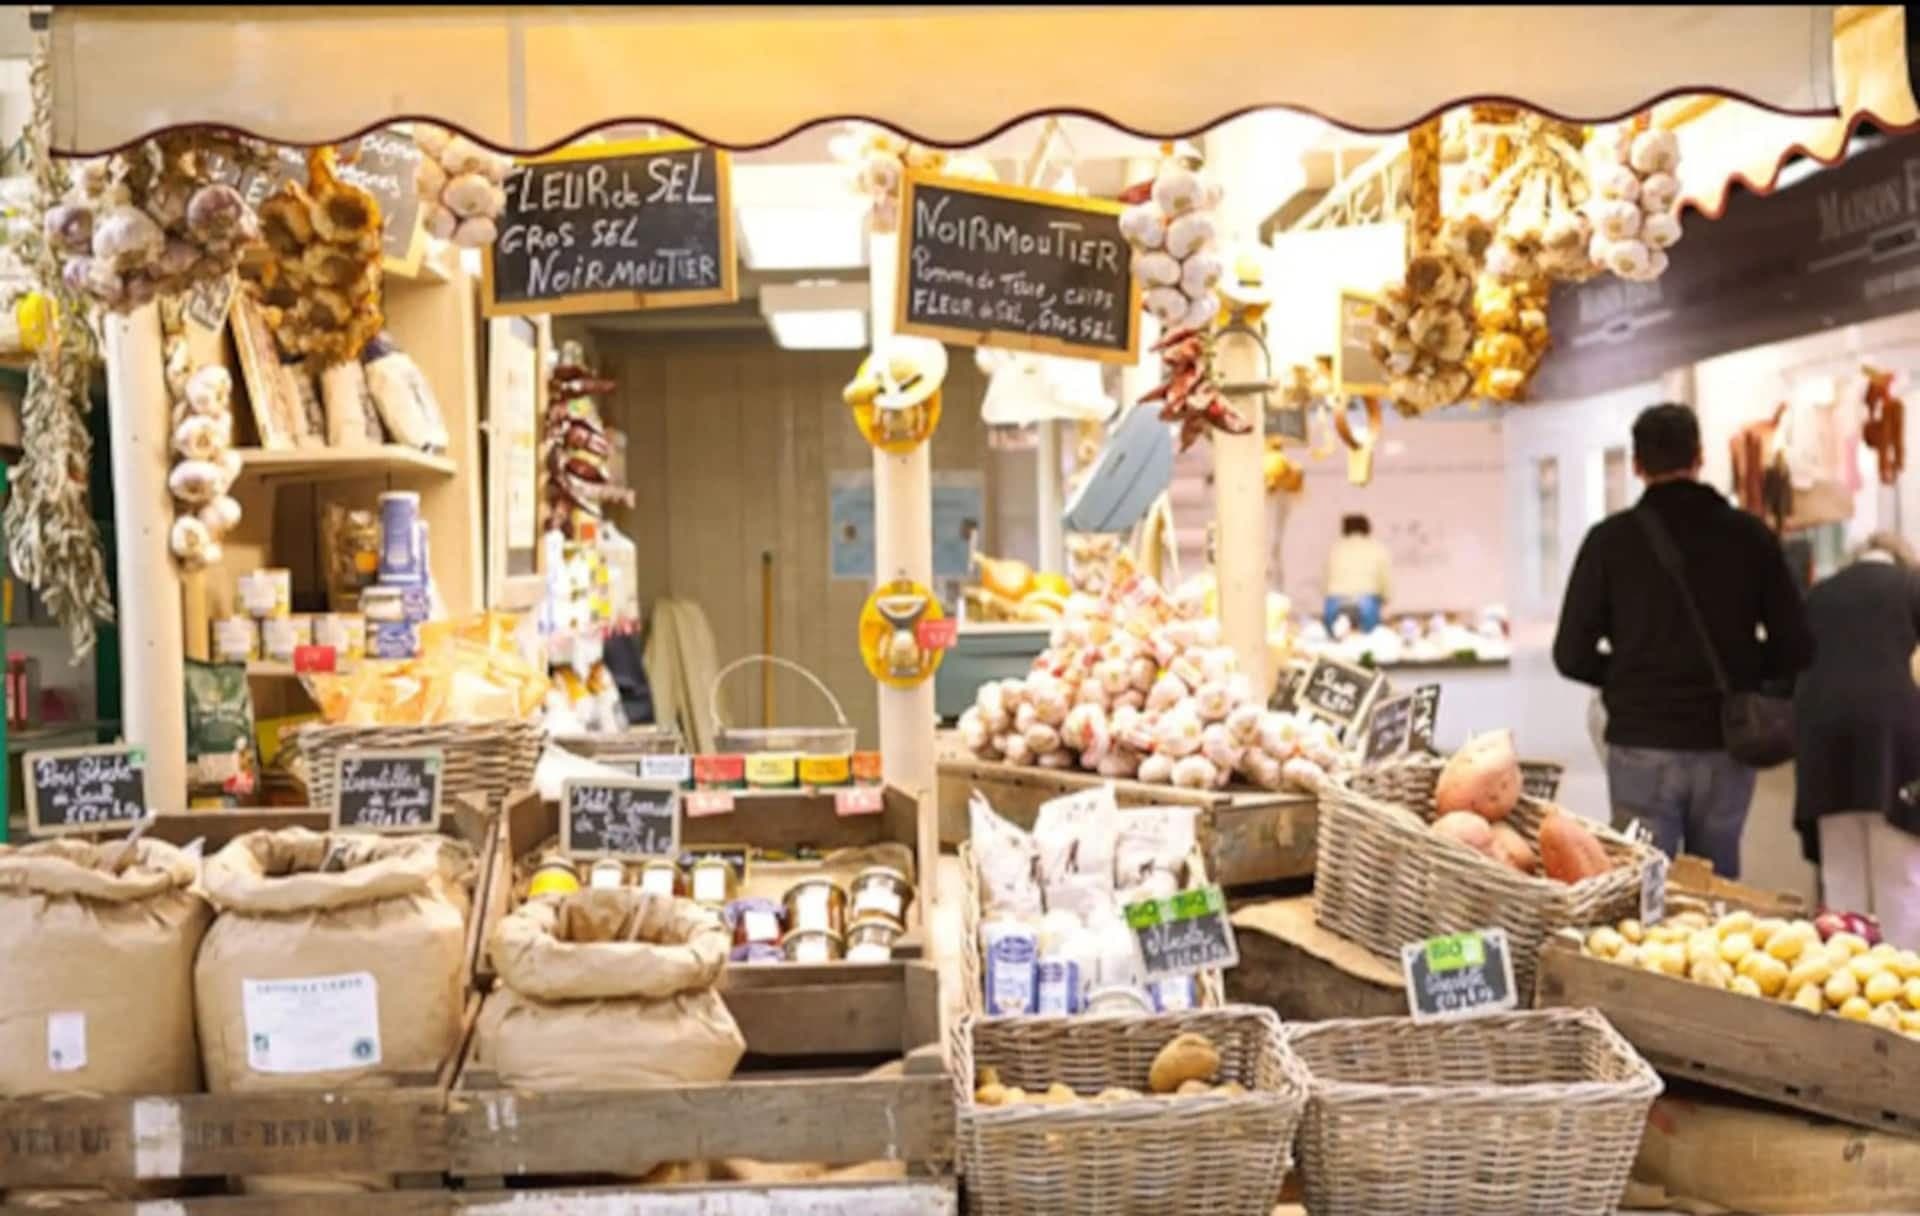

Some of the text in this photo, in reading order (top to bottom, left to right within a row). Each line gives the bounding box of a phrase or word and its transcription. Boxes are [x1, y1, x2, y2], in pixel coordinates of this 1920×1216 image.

[501, 164, 608, 213] FLEUR
[647, 153, 714, 204] SEL
[502, 217, 638, 254] GROS SEL
[913, 289, 971, 316] FLEUR
